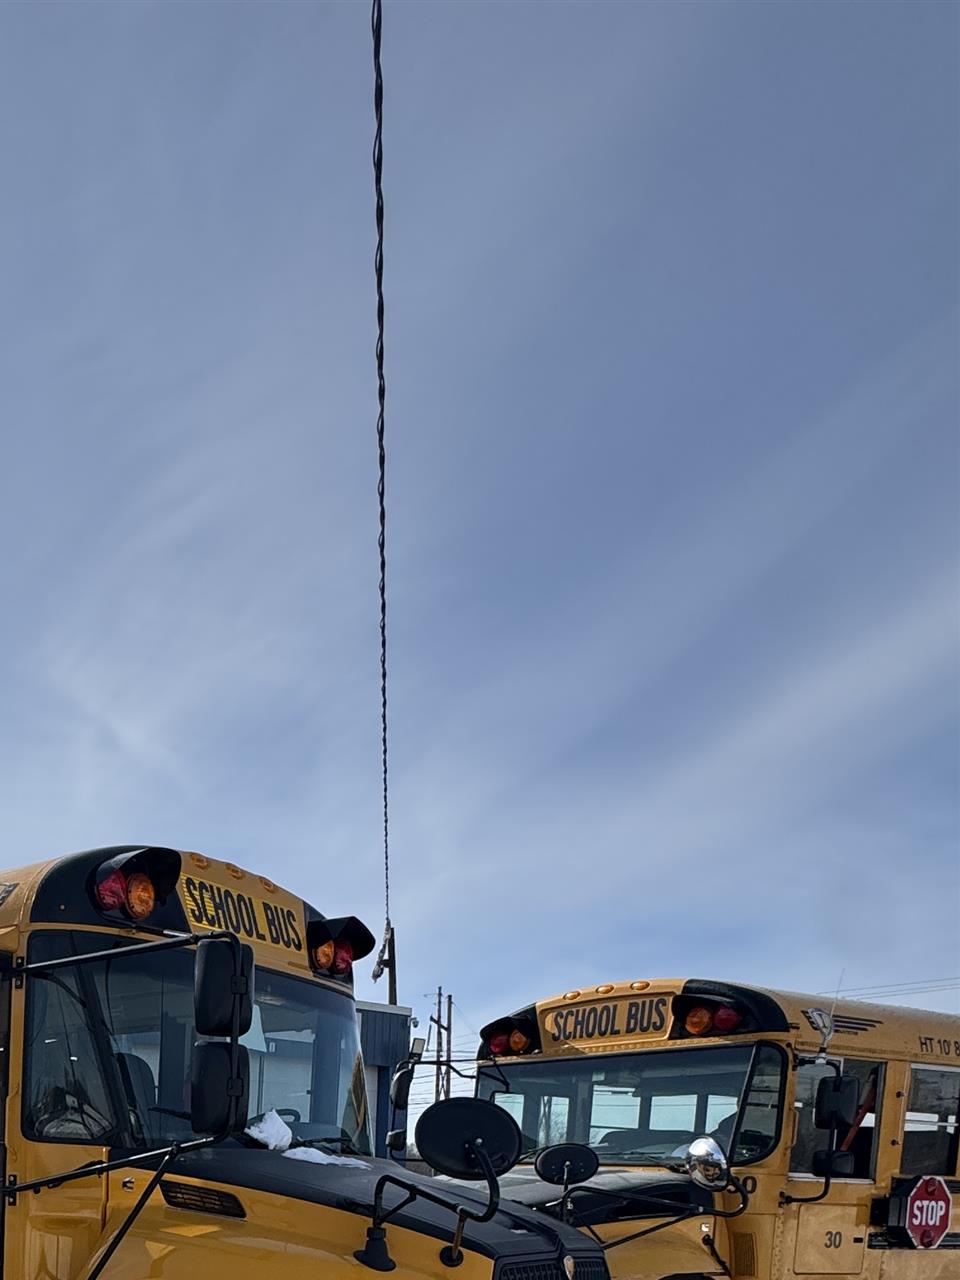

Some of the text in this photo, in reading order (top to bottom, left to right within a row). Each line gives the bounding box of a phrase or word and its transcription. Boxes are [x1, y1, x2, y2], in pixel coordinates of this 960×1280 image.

[185, 877, 302, 951] SCHOOL BUS
[551, 998, 667, 1041] SCHOOL BUS
[918, 1035, 934, 1053] HT
[912, 1200, 946, 1226] STOP
[824, 1231, 843, 1249] 30
